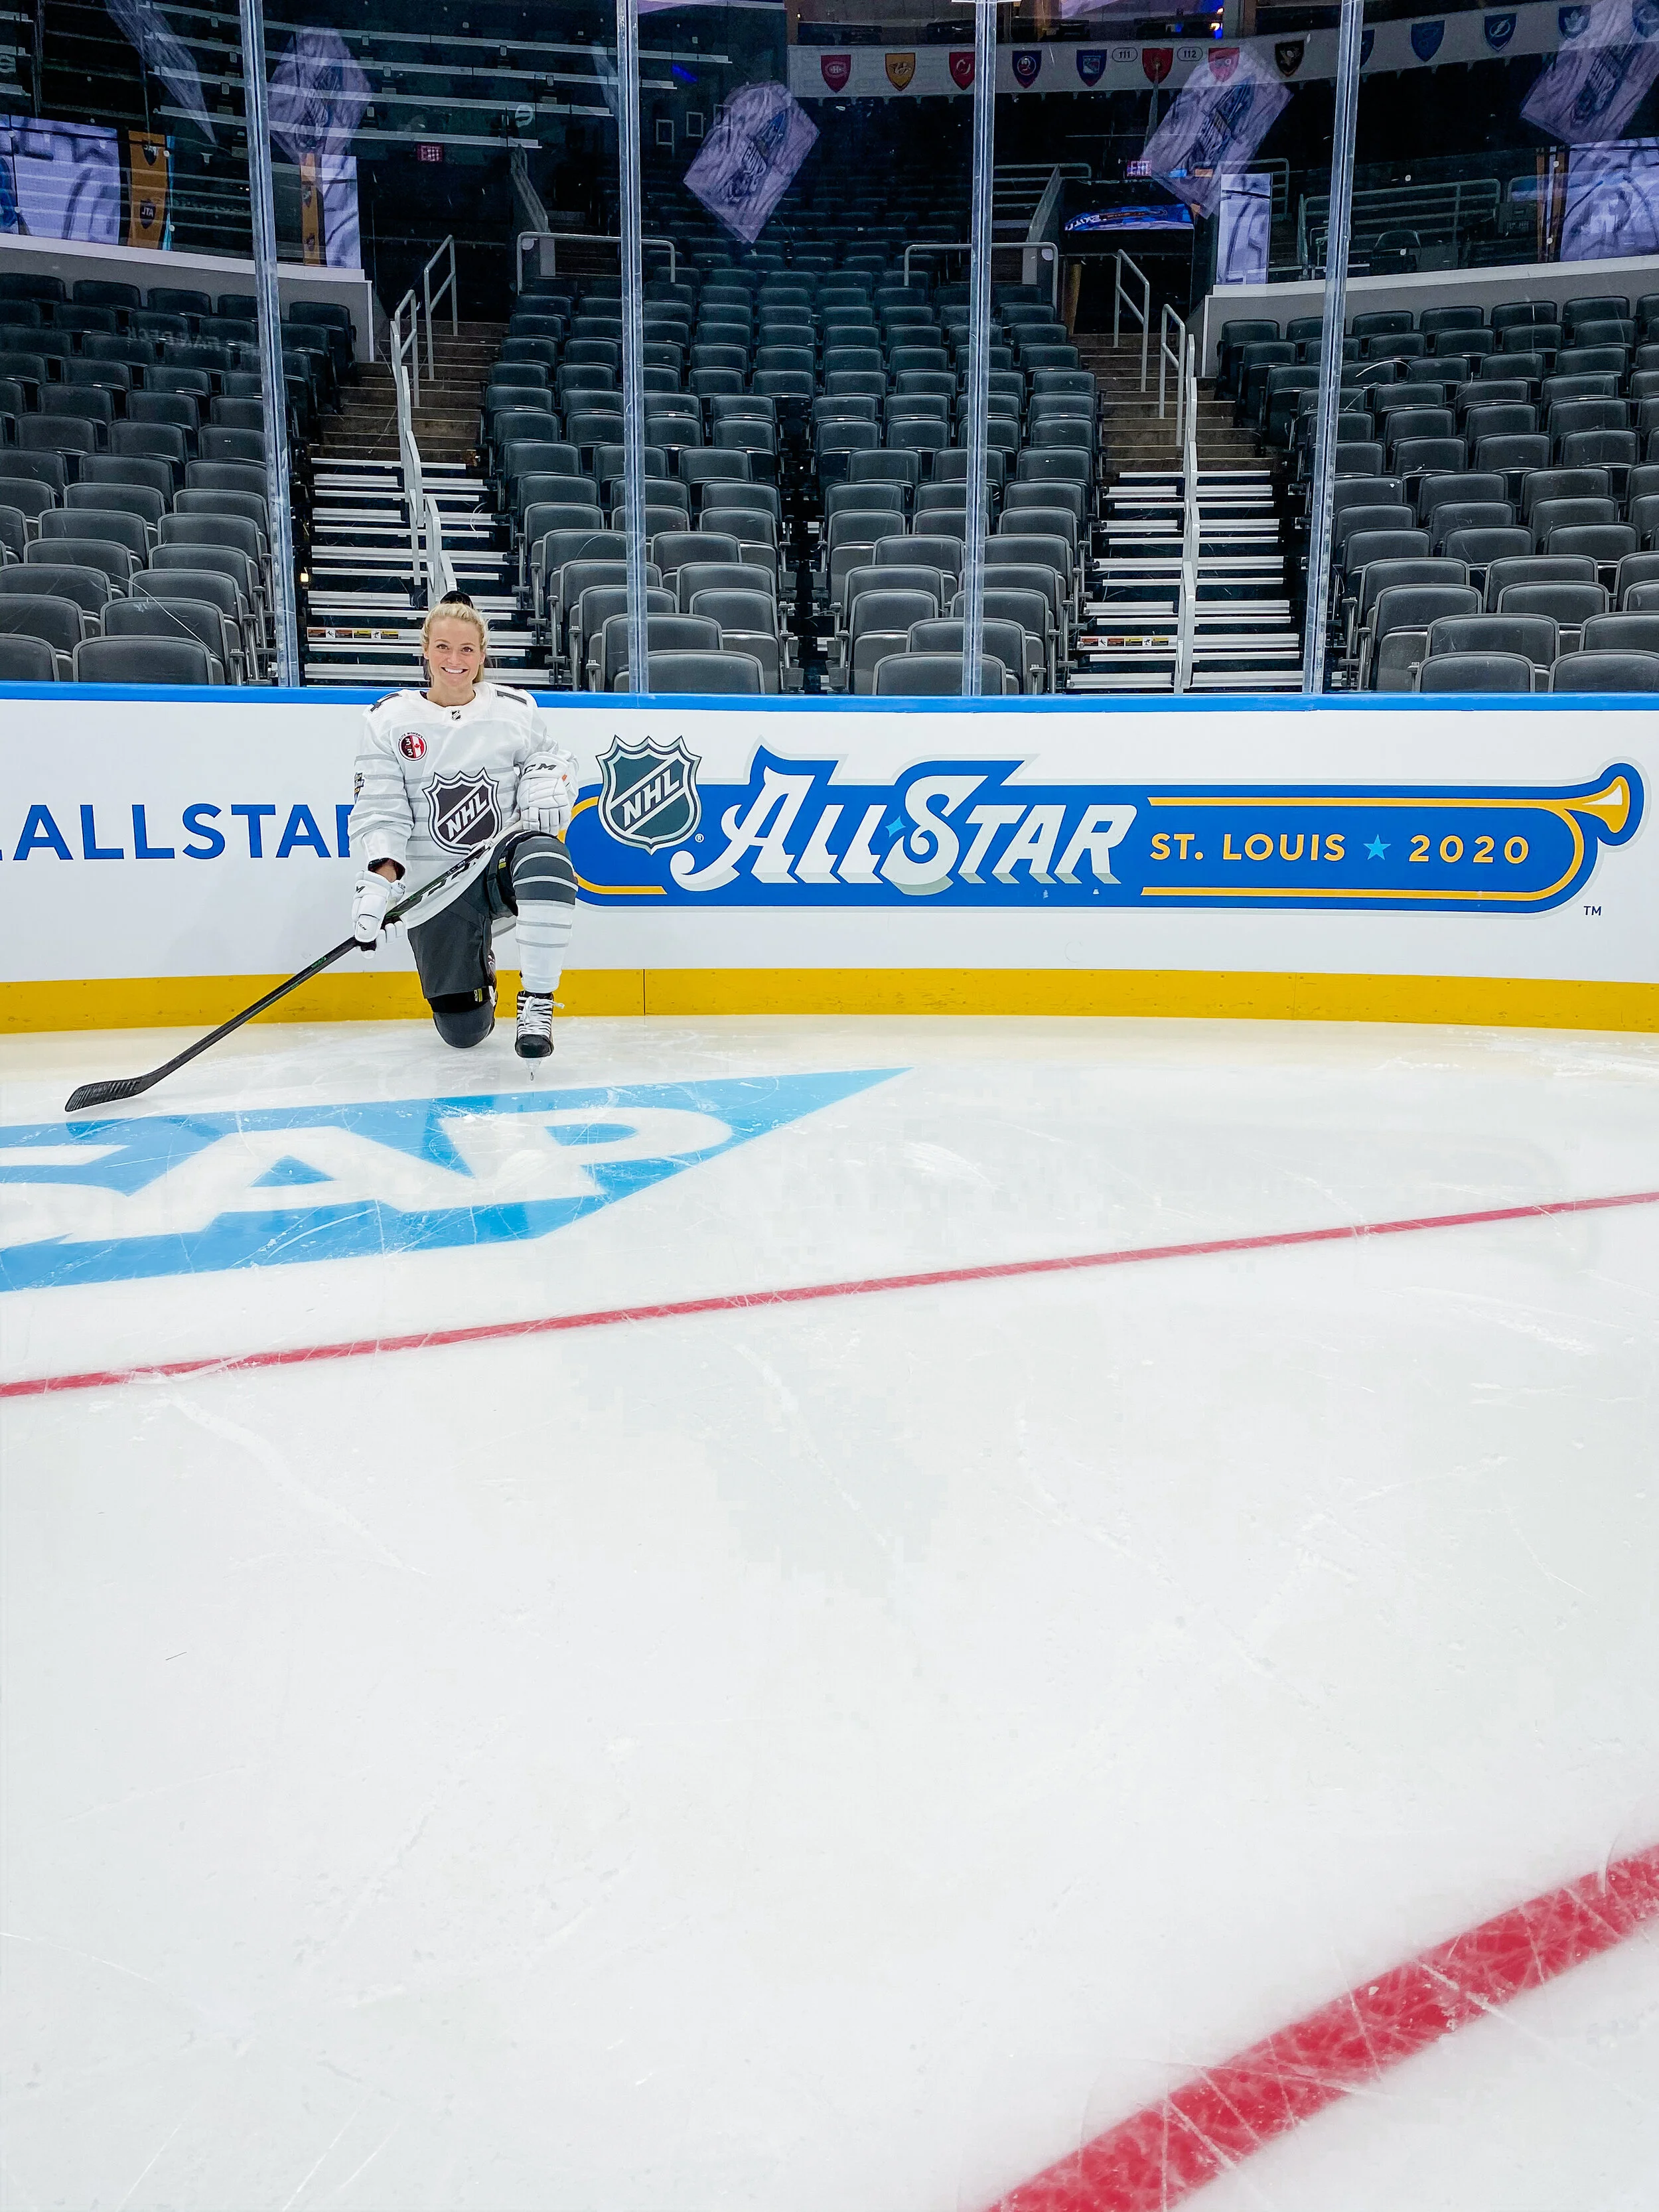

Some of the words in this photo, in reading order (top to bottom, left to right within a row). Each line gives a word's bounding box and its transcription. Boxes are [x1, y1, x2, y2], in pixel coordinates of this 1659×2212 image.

[1119, 50, 1131, 59] 111
[1183, 50, 1196, 58] 112
[524, 763, 557, 774] CM
[621, 769, 680, 828] NHL
[445, 792, 488, 840] NHL
[0, 803, 354, 861] ALLSTA
[1149, 833, 1204, 861] ST.
[1222, 834, 1346, 861] LOUIS
[1408, 834, 1530, 864] 2020
[1583, 905, 1603, 917] TM
